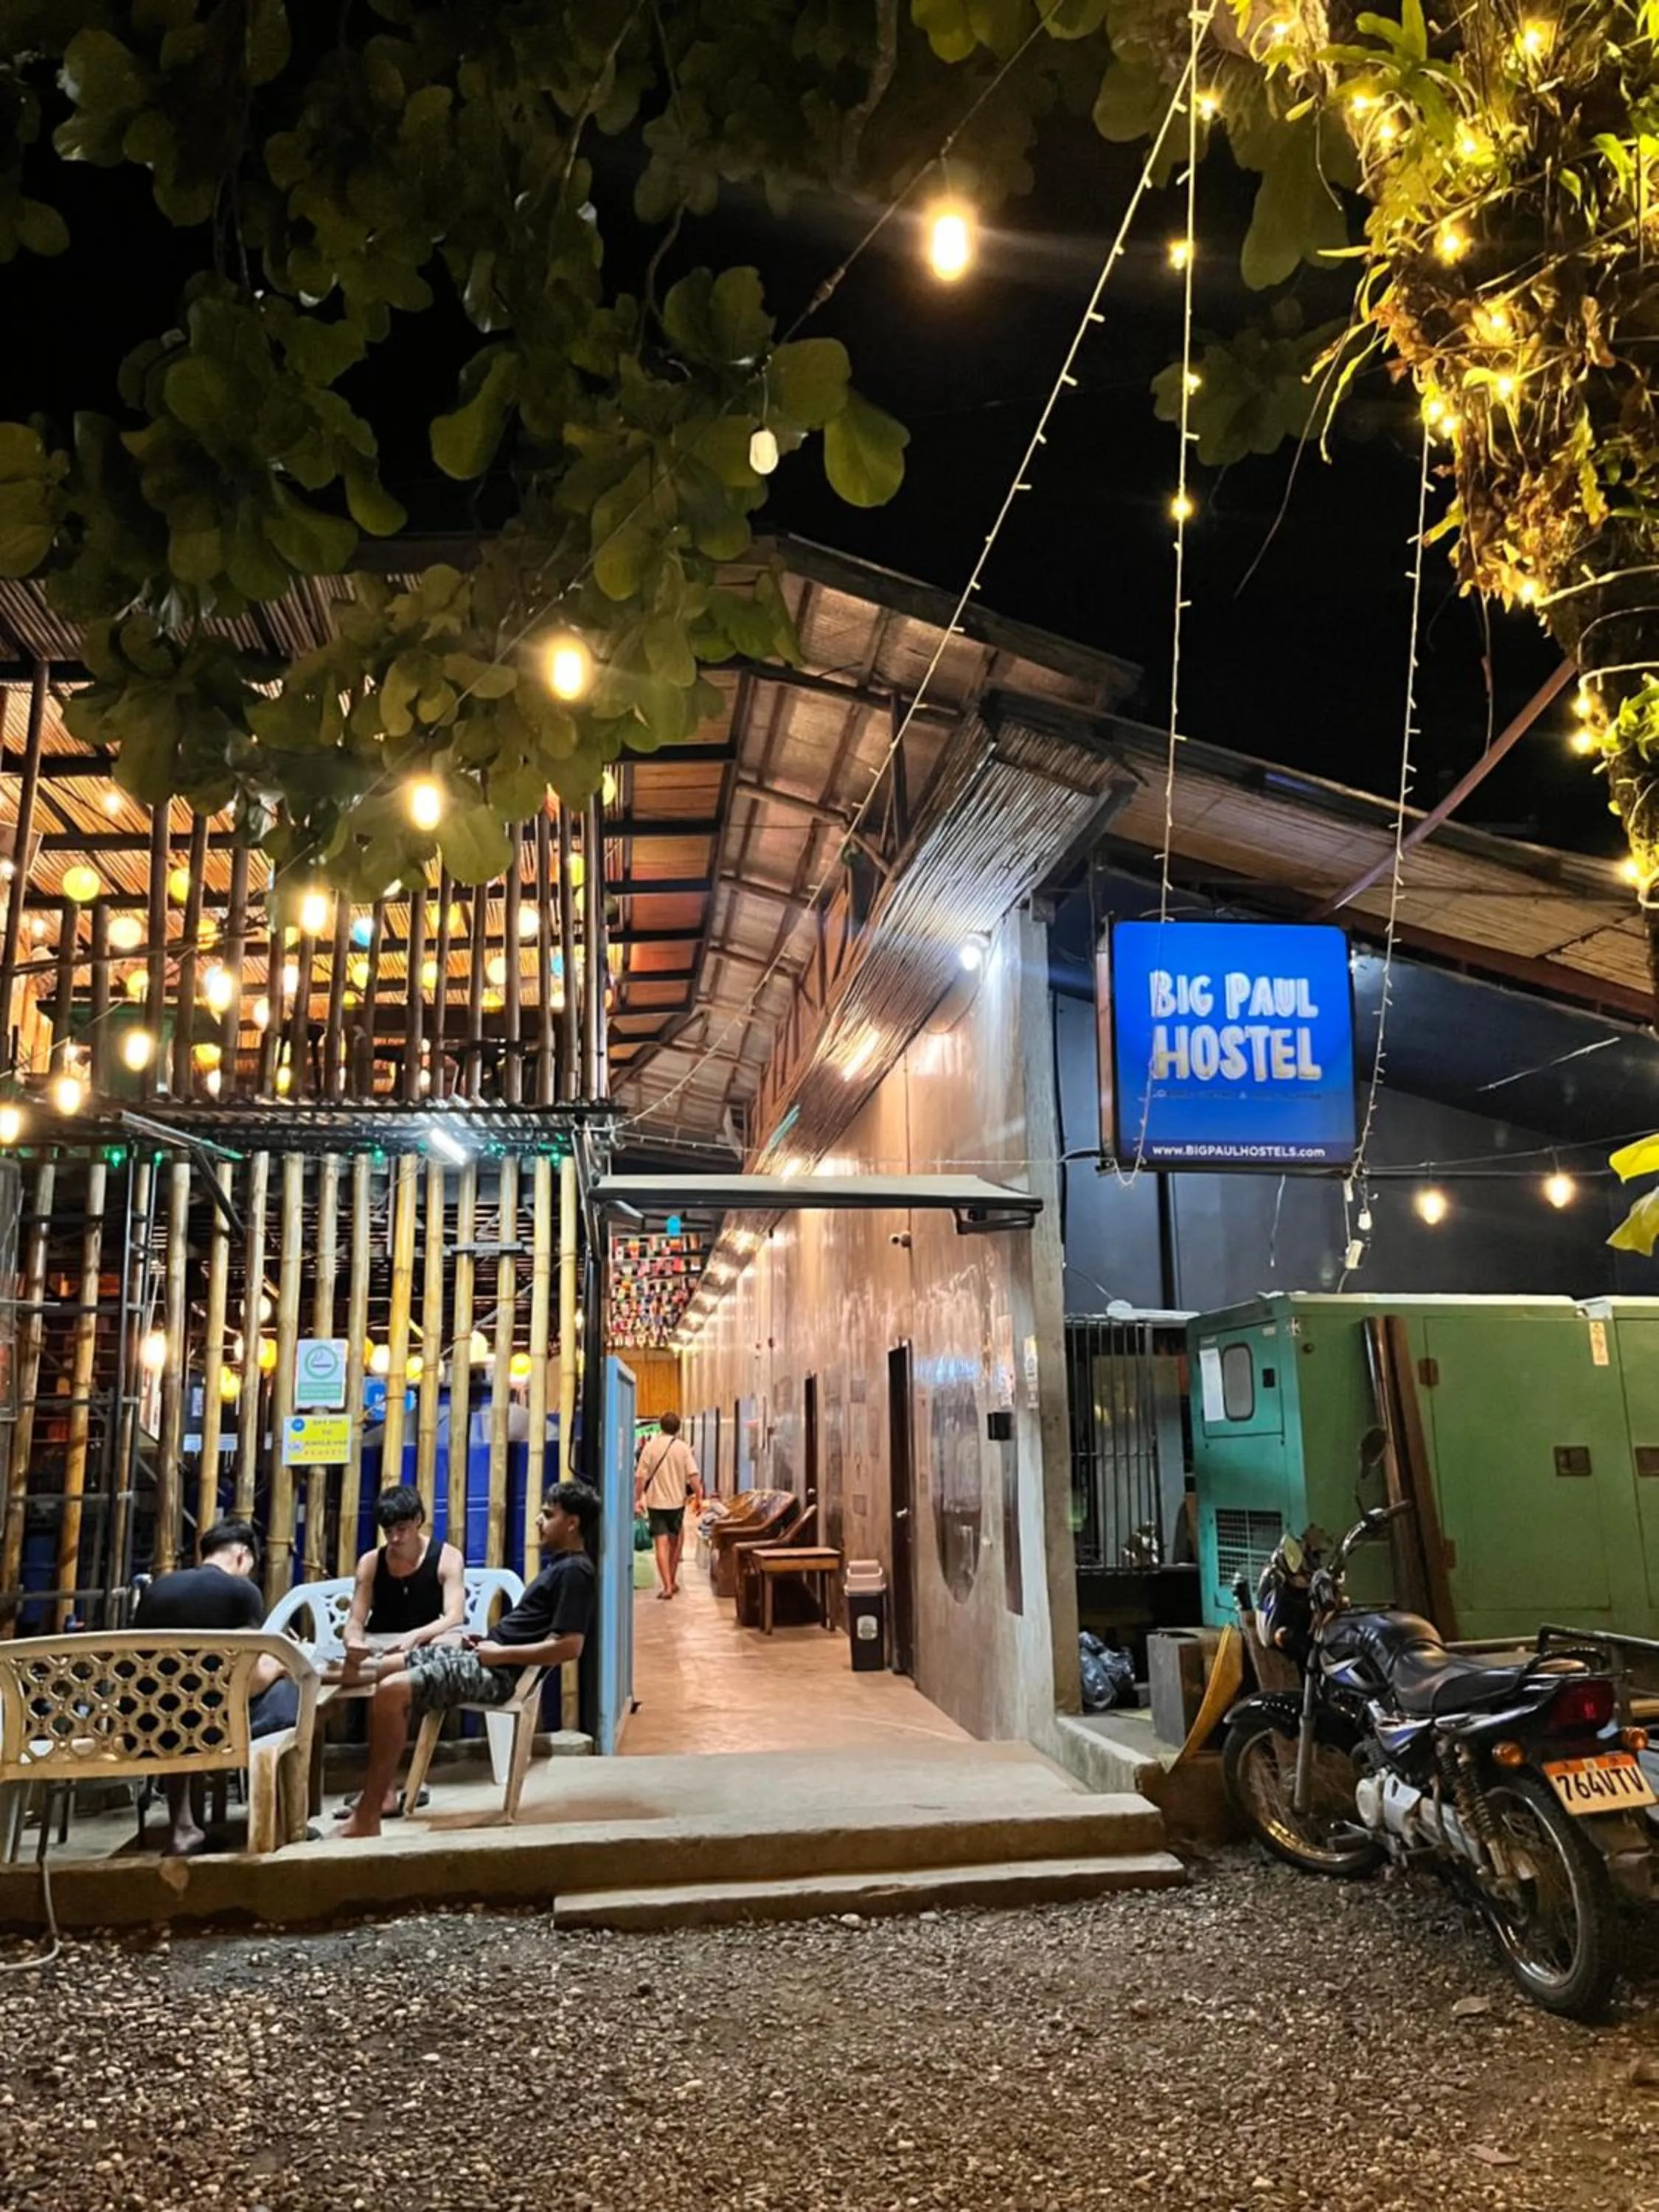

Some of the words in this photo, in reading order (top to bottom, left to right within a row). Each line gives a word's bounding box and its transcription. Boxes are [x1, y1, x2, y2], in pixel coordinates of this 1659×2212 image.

[1150, 970, 1214, 1018] BIG
[1225, 972, 1319, 1020] PAUL
[1151, 1024, 1322, 1082] HOSTEL
[1152, 1144, 1326, 1158] www.BIGPAULHOSTELS.com
[1557, 1767, 1644, 1801] 764VTV
